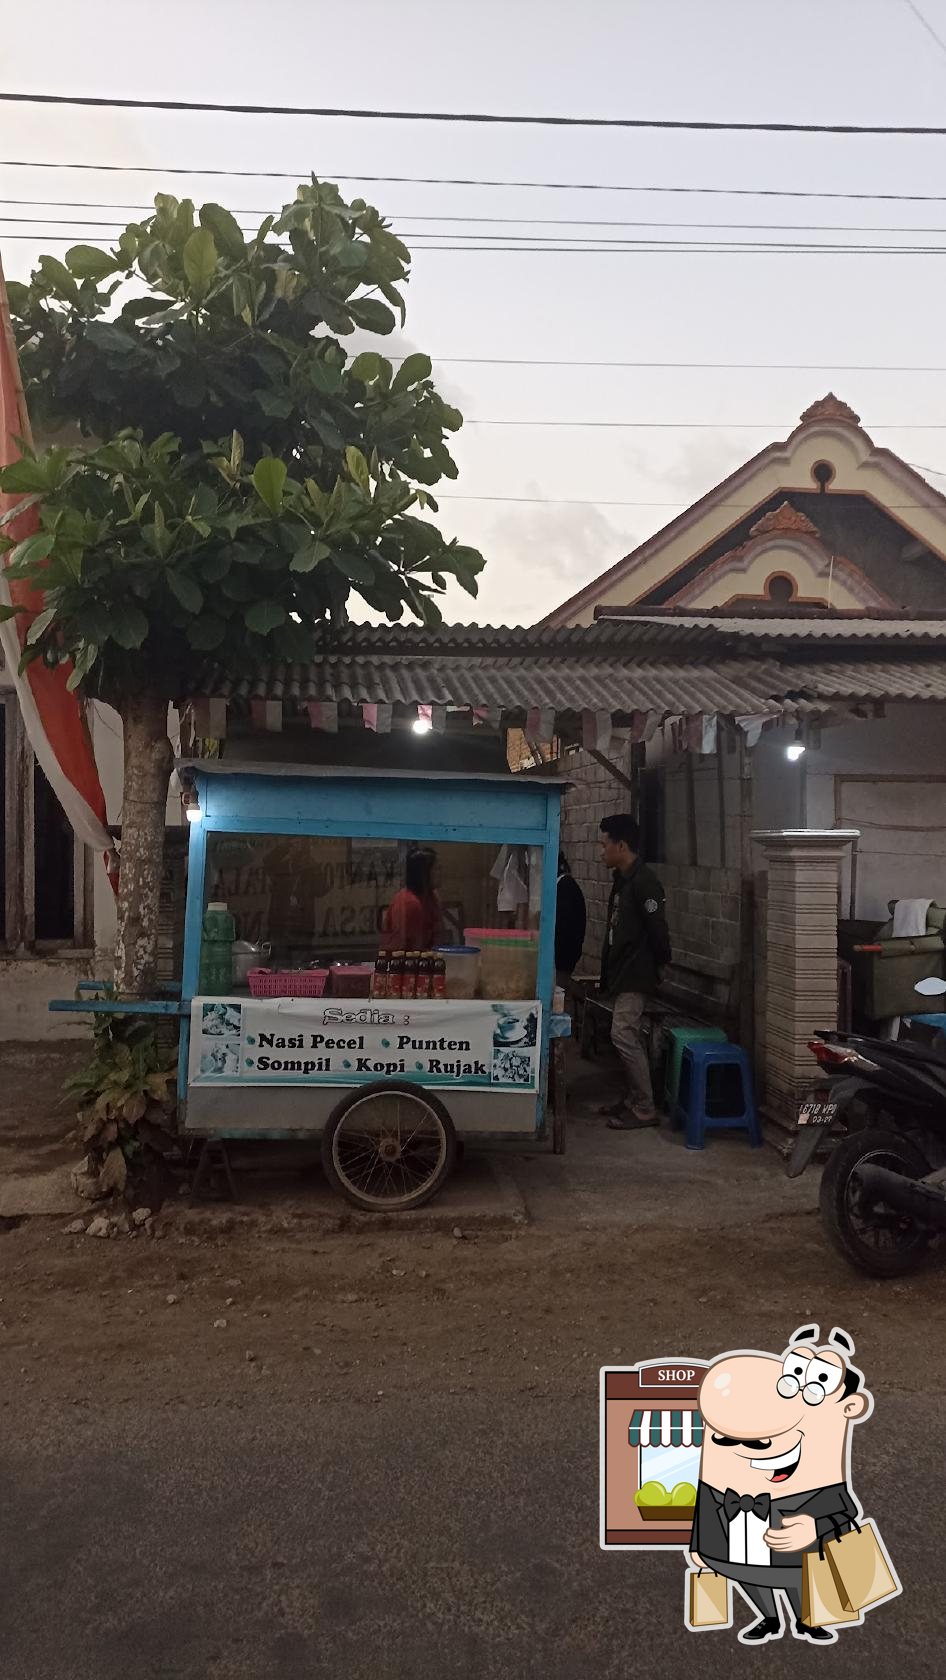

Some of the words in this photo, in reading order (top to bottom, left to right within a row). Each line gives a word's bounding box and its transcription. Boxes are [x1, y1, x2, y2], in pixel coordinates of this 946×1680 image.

[323, 1008, 395, 1025] Sedia
[257, 1033, 304, 1049] Nasi
[310, 1035, 365, 1050] Pecel
[397, 1036, 471, 1051] Punten
[256, 1056, 332, 1075] Sompil
[356, 1058, 406, 1075] Kopi
[428, 1060, 487, 1078] Rujak
